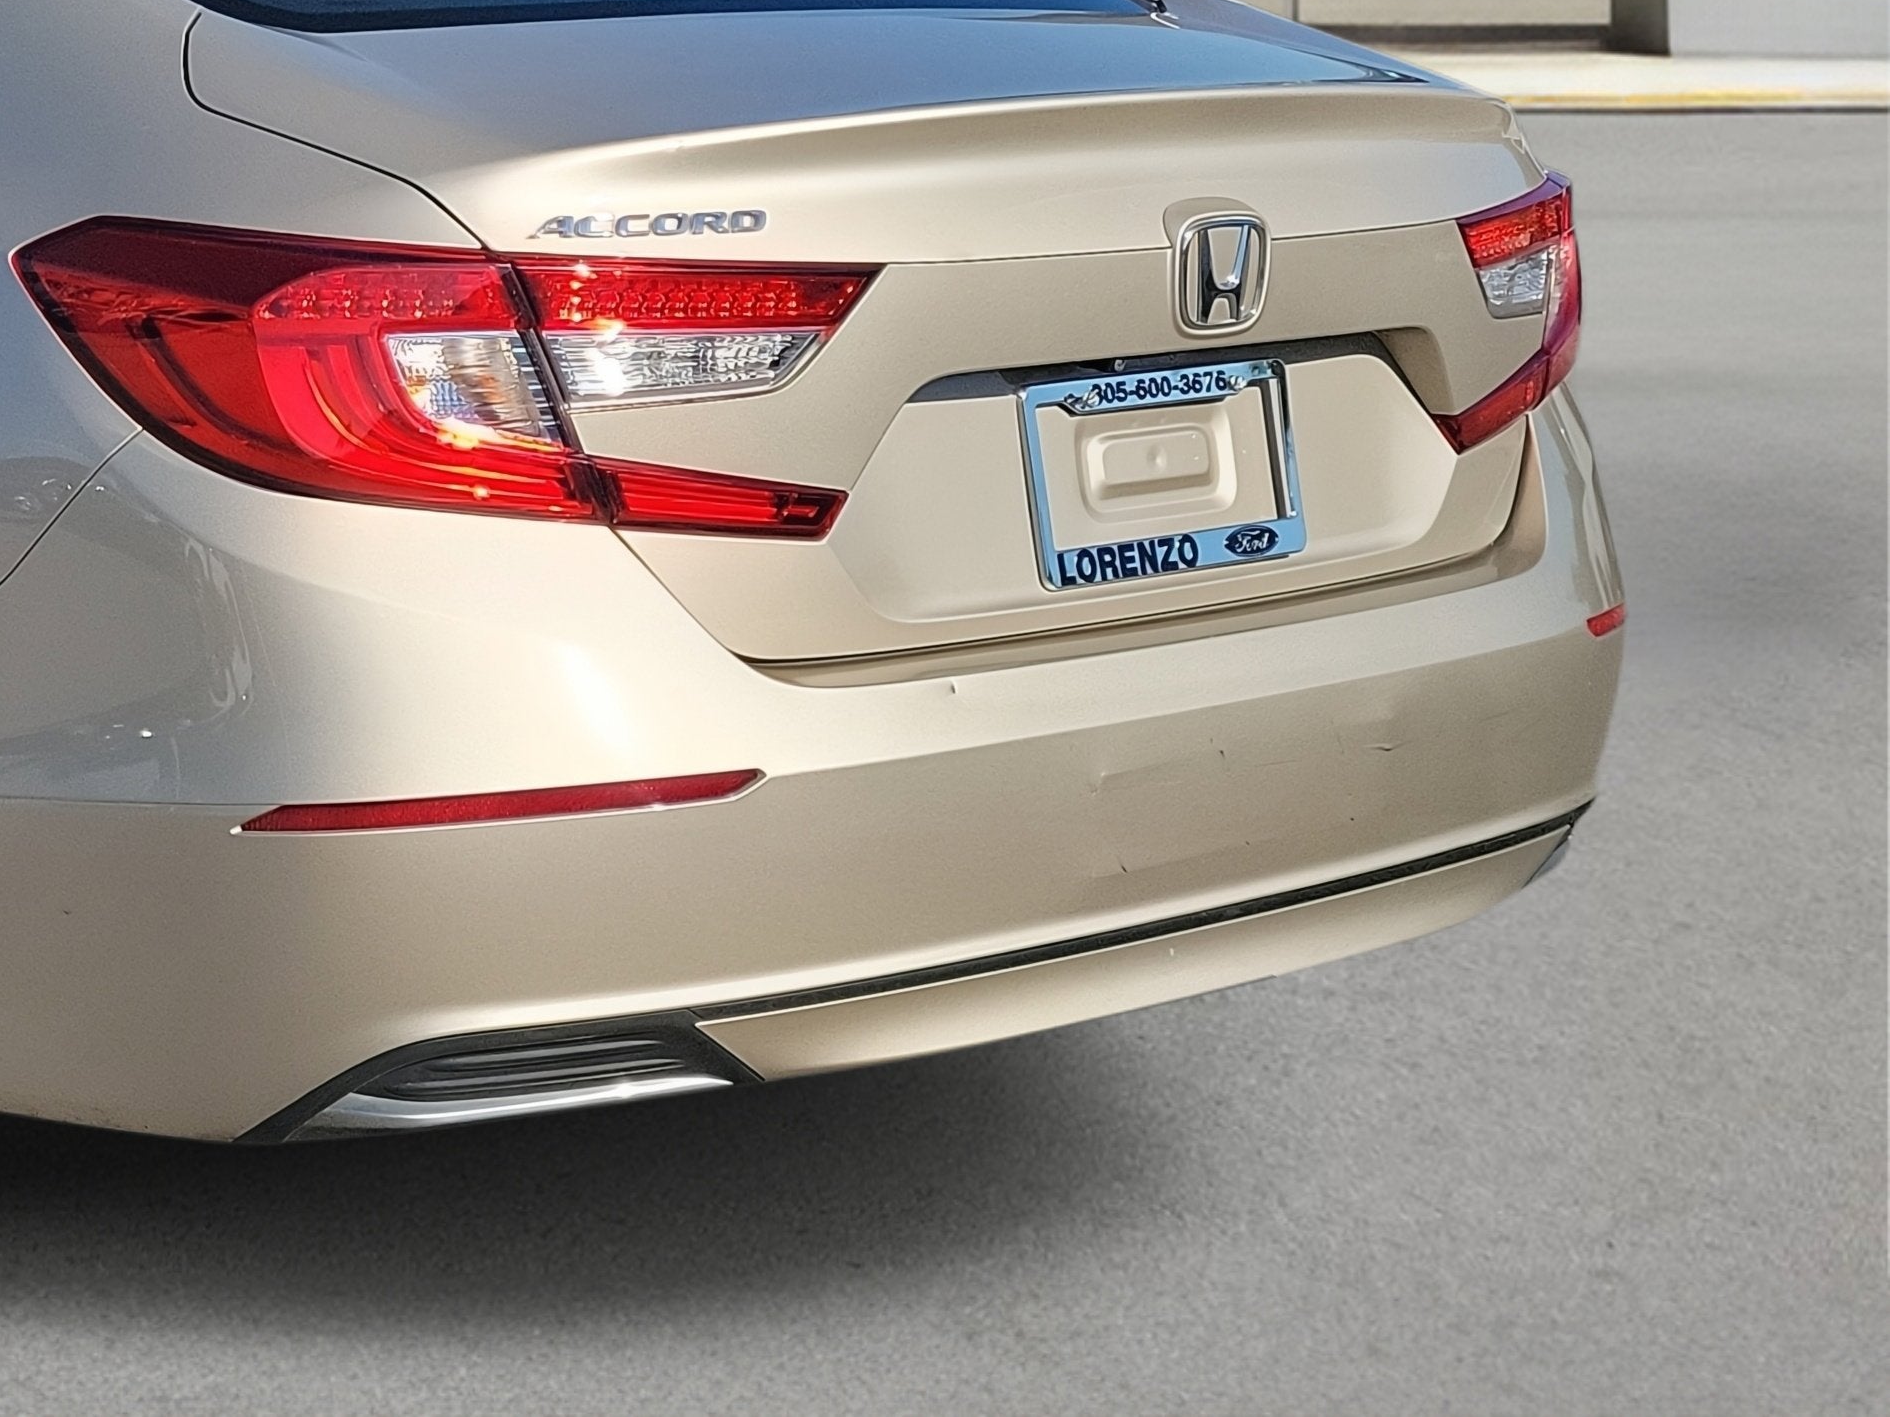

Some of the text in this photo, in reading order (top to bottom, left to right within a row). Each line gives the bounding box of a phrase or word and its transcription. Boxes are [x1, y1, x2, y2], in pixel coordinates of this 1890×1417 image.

[525, 209, 768, 240] ACCORD
[1056, 529, 1271, 587] LORENZO Ford
